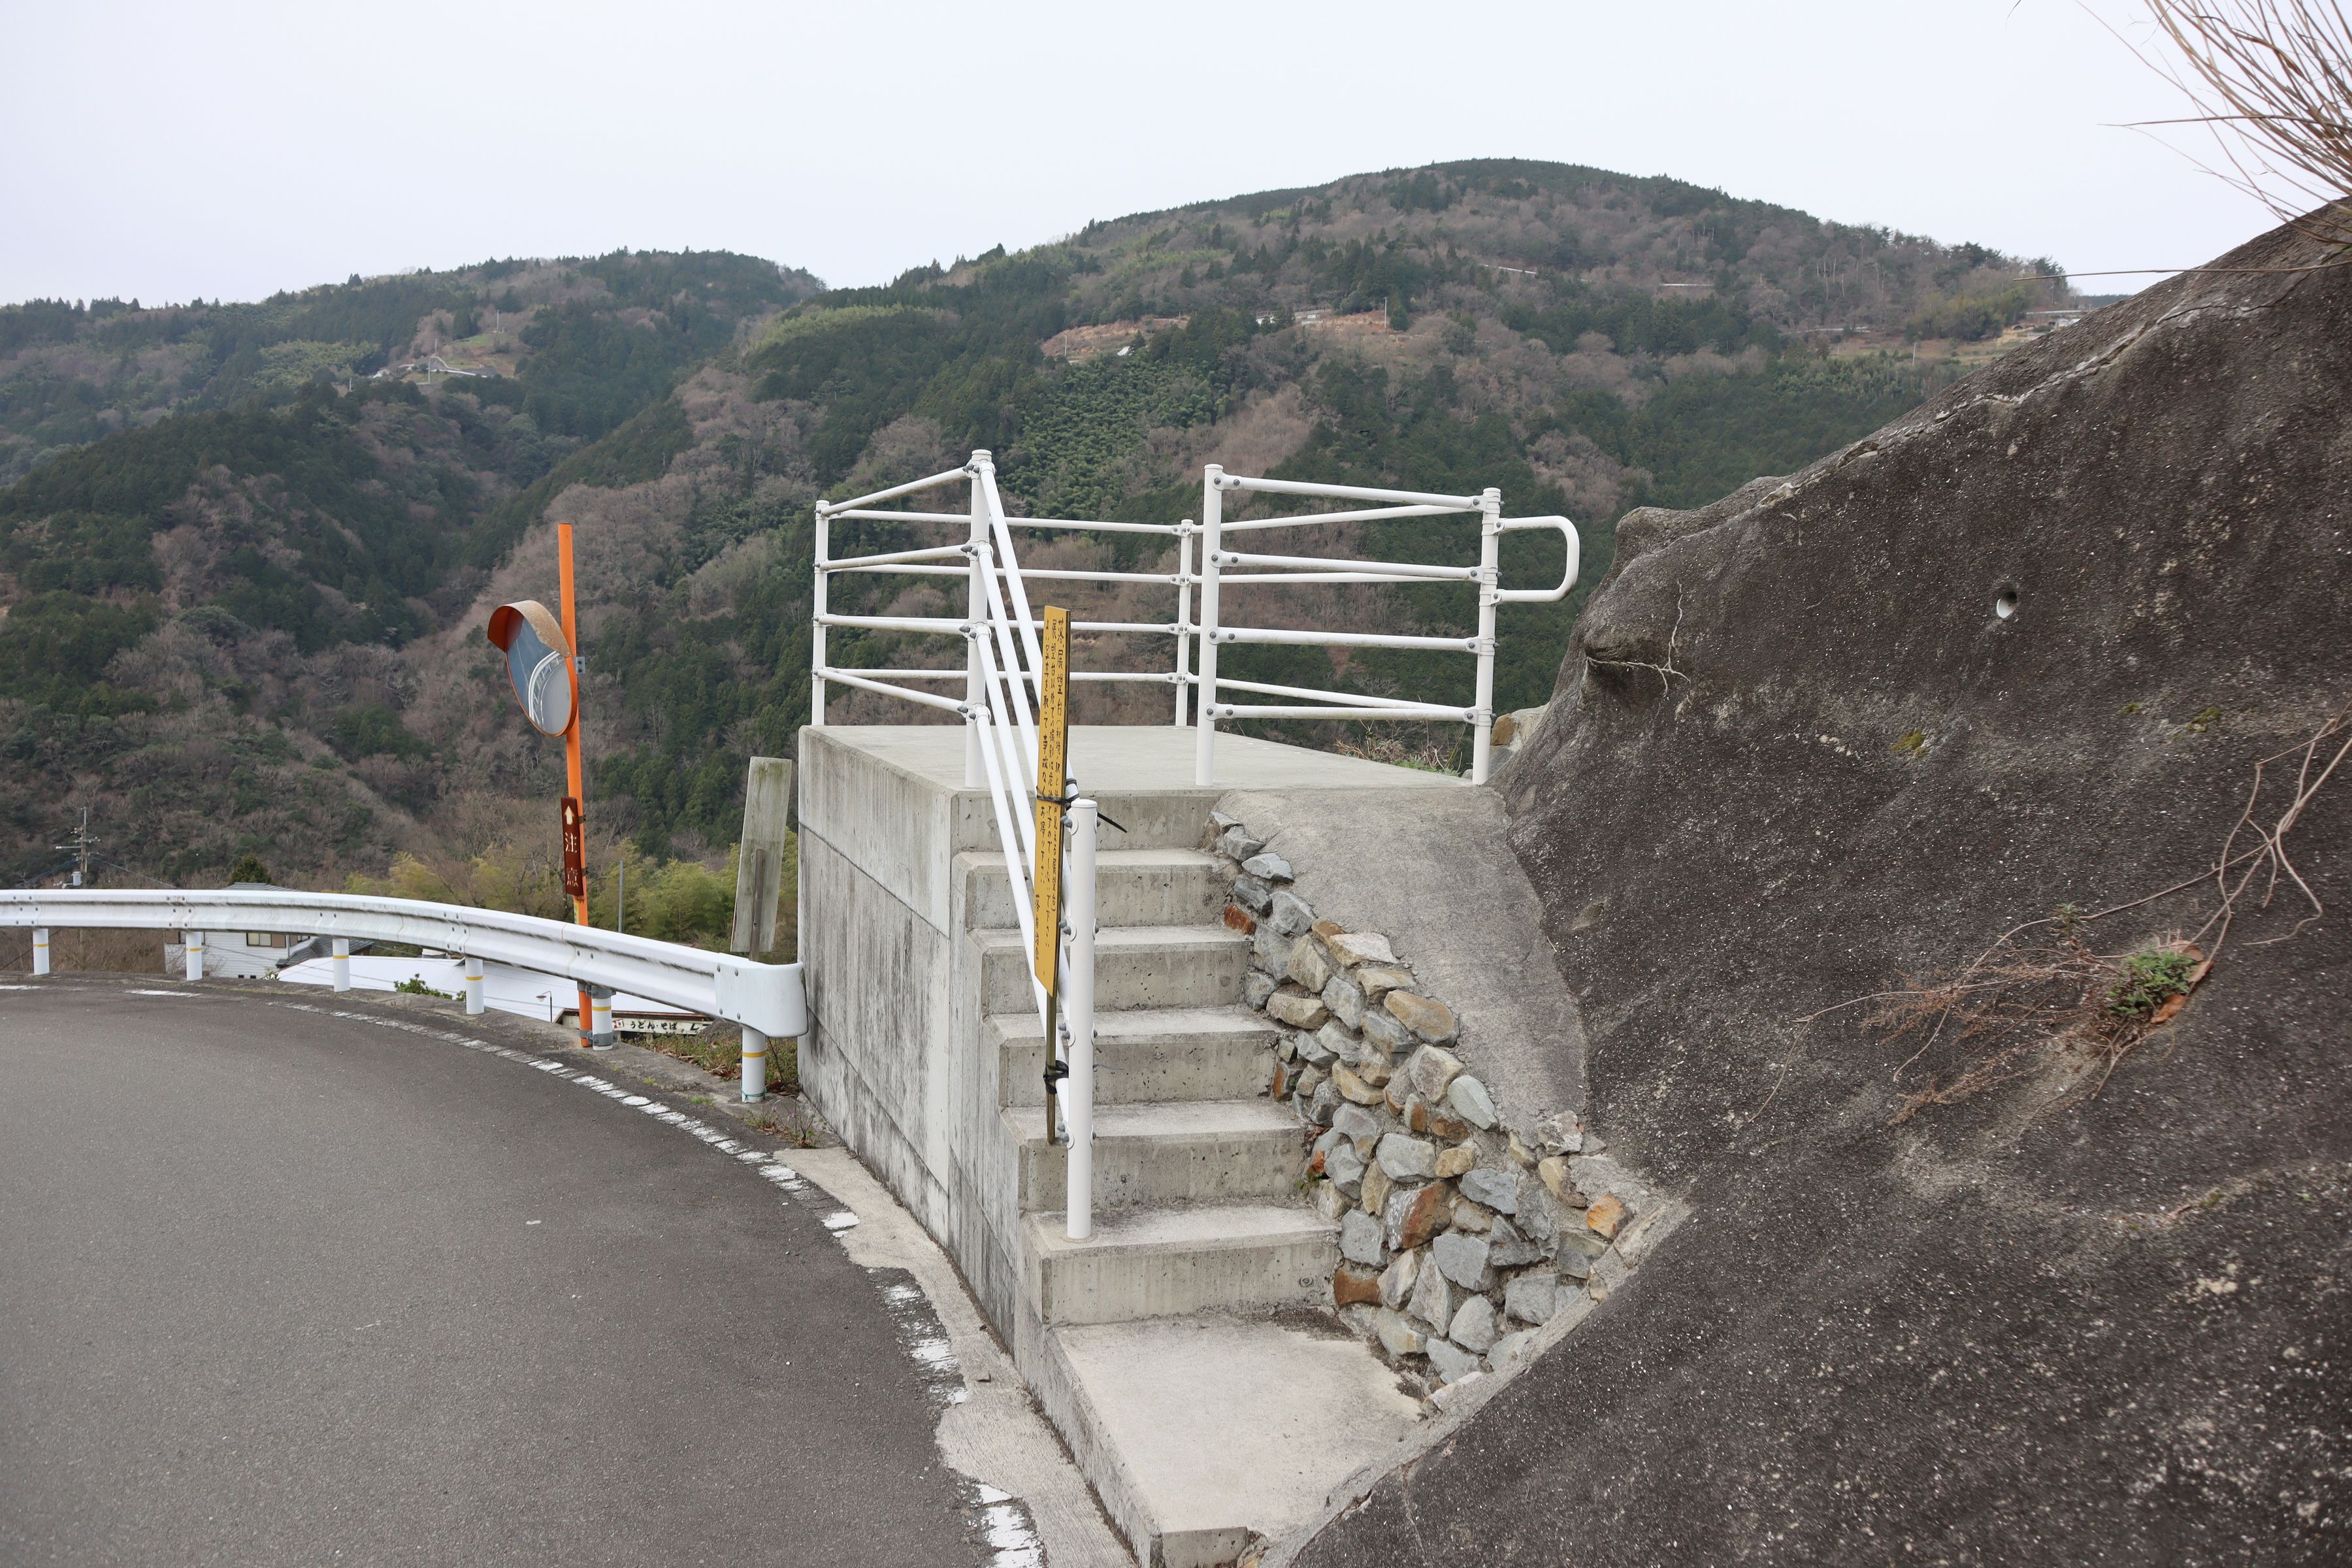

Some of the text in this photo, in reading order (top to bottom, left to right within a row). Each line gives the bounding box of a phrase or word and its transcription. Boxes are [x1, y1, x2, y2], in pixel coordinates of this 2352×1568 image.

[564, 832, 579, 887] 注意
[630, 1021, 678, 1030] うどん・そば
